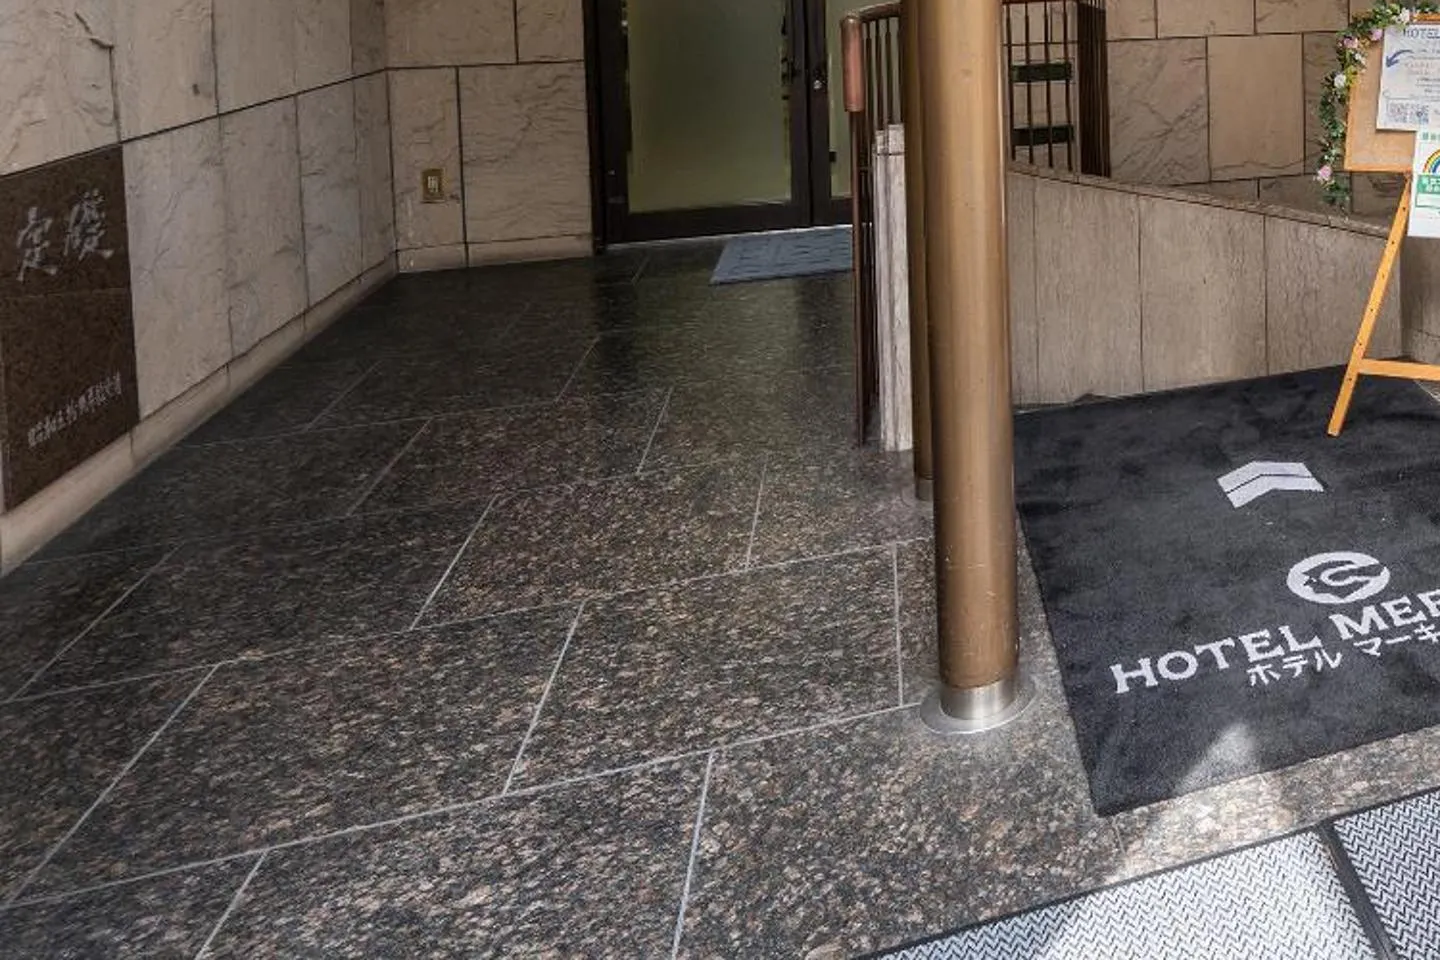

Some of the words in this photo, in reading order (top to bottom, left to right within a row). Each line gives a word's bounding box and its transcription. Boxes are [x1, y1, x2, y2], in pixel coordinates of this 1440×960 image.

[1110, 625, 1323, 694] HOTEL
[1246, 650, 1342, 687] ホテル
